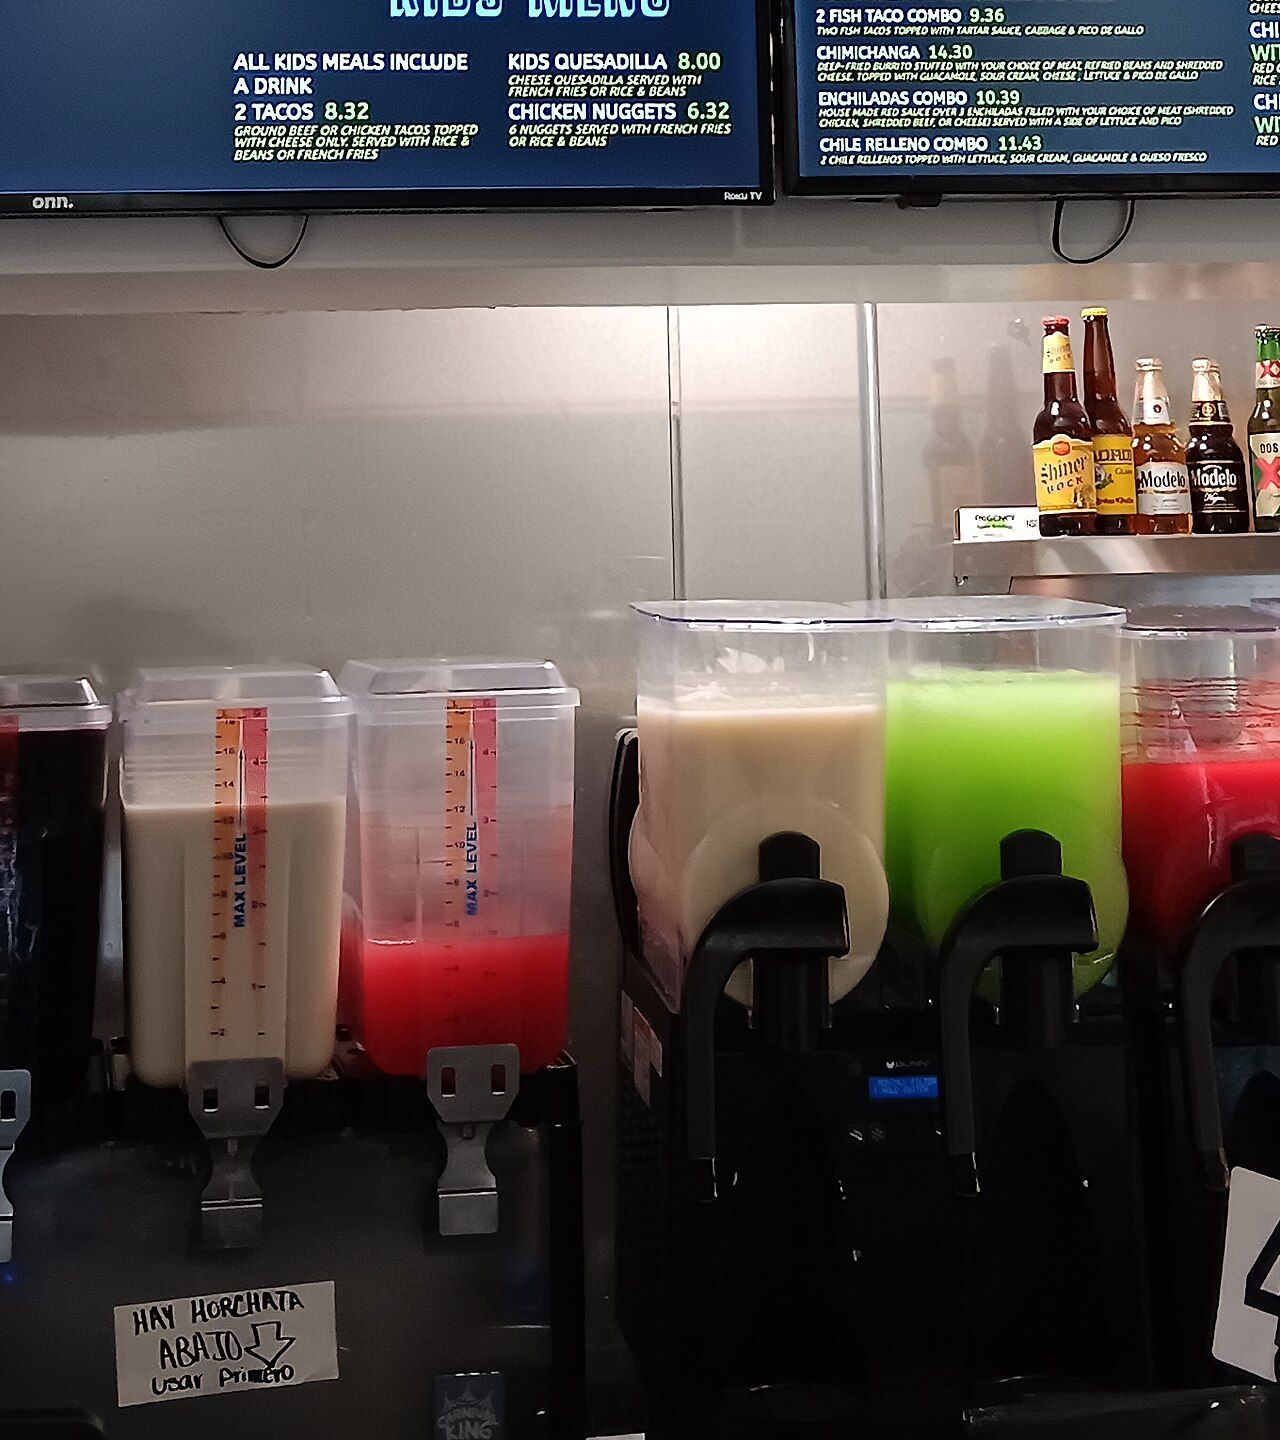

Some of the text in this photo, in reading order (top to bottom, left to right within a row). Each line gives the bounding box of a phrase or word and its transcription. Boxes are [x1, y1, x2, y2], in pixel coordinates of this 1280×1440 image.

[817, 45, 972, 60] CHIMICHANGA 14.30
[508, 53, 720, 70] KIDS QUESADILLA 8.00
[509, 123, 731, 135] 6 NUGGETS SERVED WITH FRENCH FRIES
[1141, 471, 1185, 488] Modelo
[234, 833, 246, 928] MAX LEVEL
[133, 1290, 304, 1335] HAY HORCHATA
[159, 1330, 242, 1370] ABAJO
